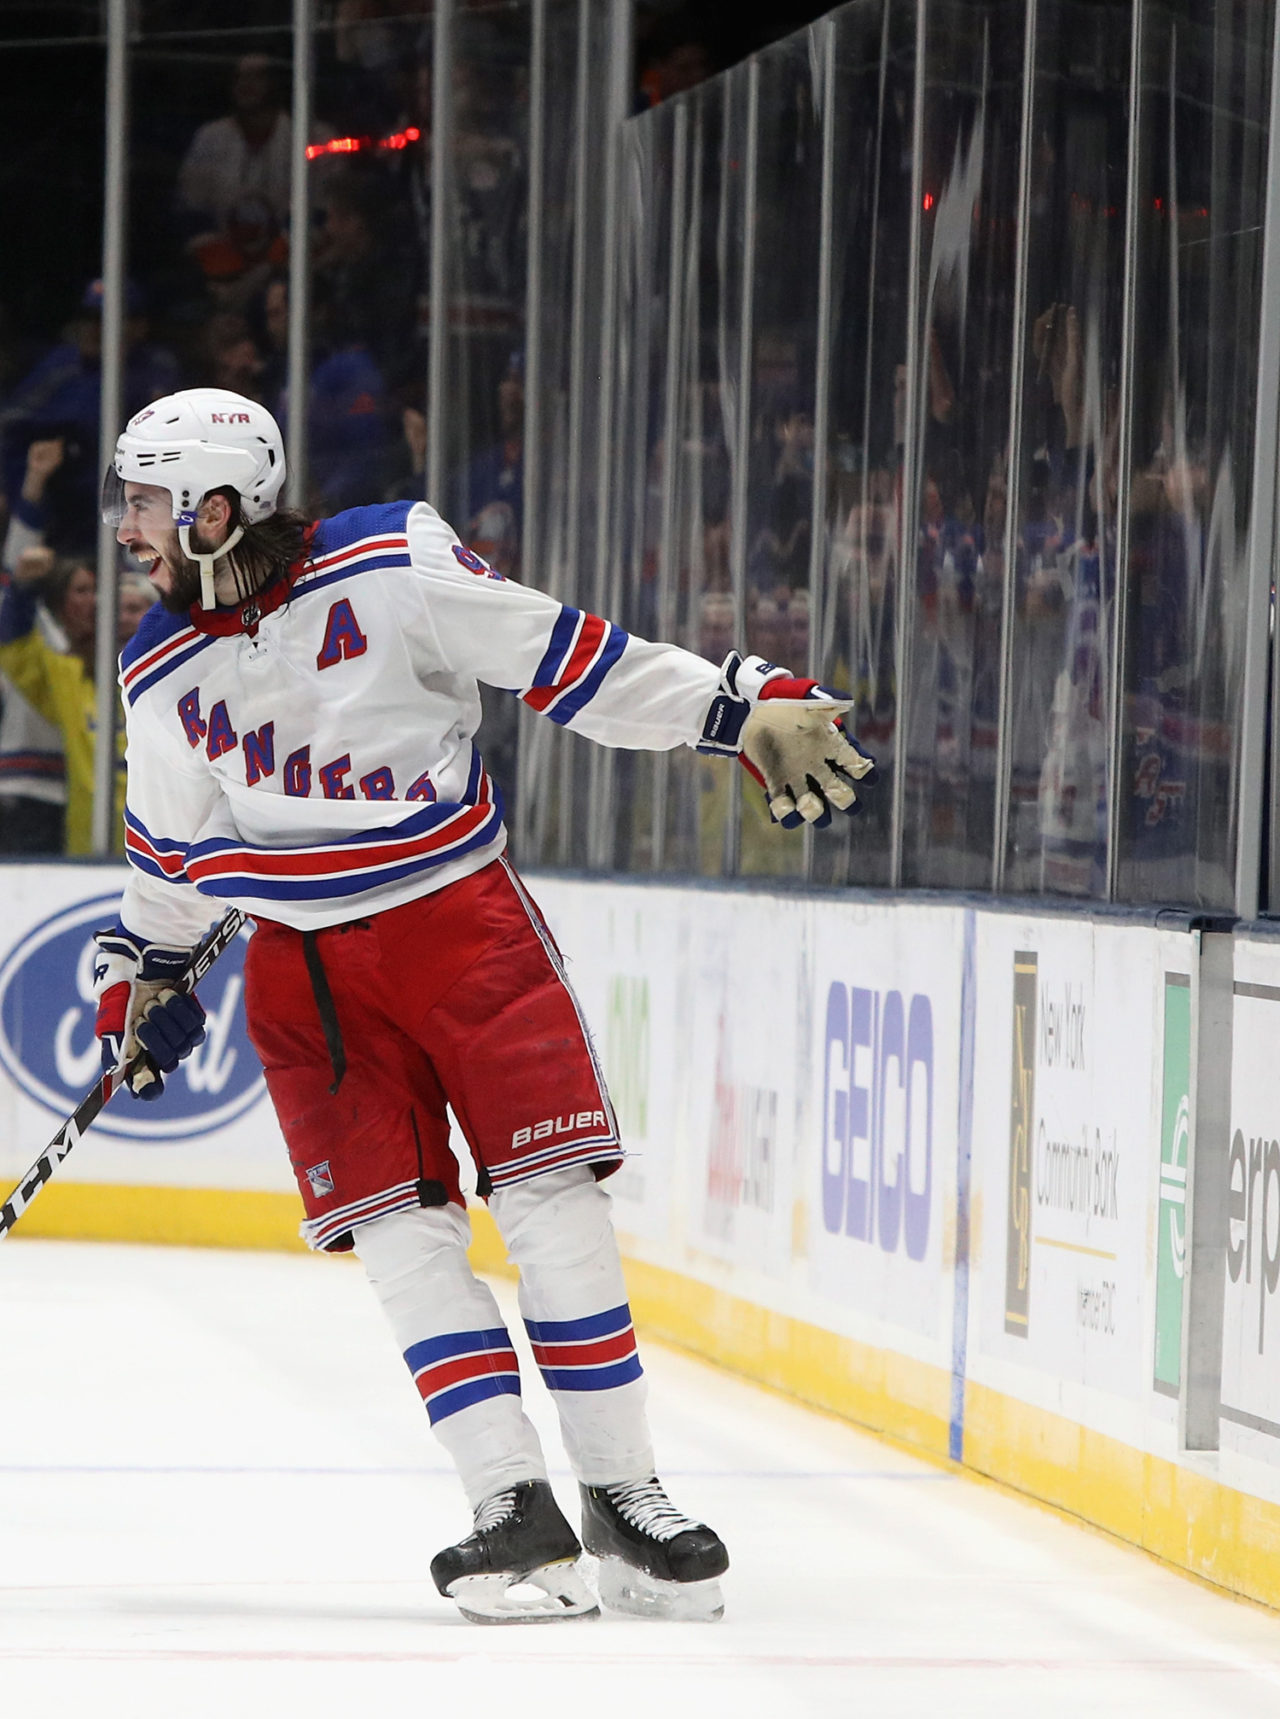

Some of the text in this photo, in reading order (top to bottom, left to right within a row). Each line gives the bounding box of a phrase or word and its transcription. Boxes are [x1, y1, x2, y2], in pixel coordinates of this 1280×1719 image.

[211, 412, 251, 424] NYR
[317, 597, 368, 672] A
[177, 686, 438, 802] RANGERS
[1040, 982, 1086, 1071] New York
[822, 980, 934, 1263] GEICO
[1036, 1117, 1119, 1238] Community Bank
